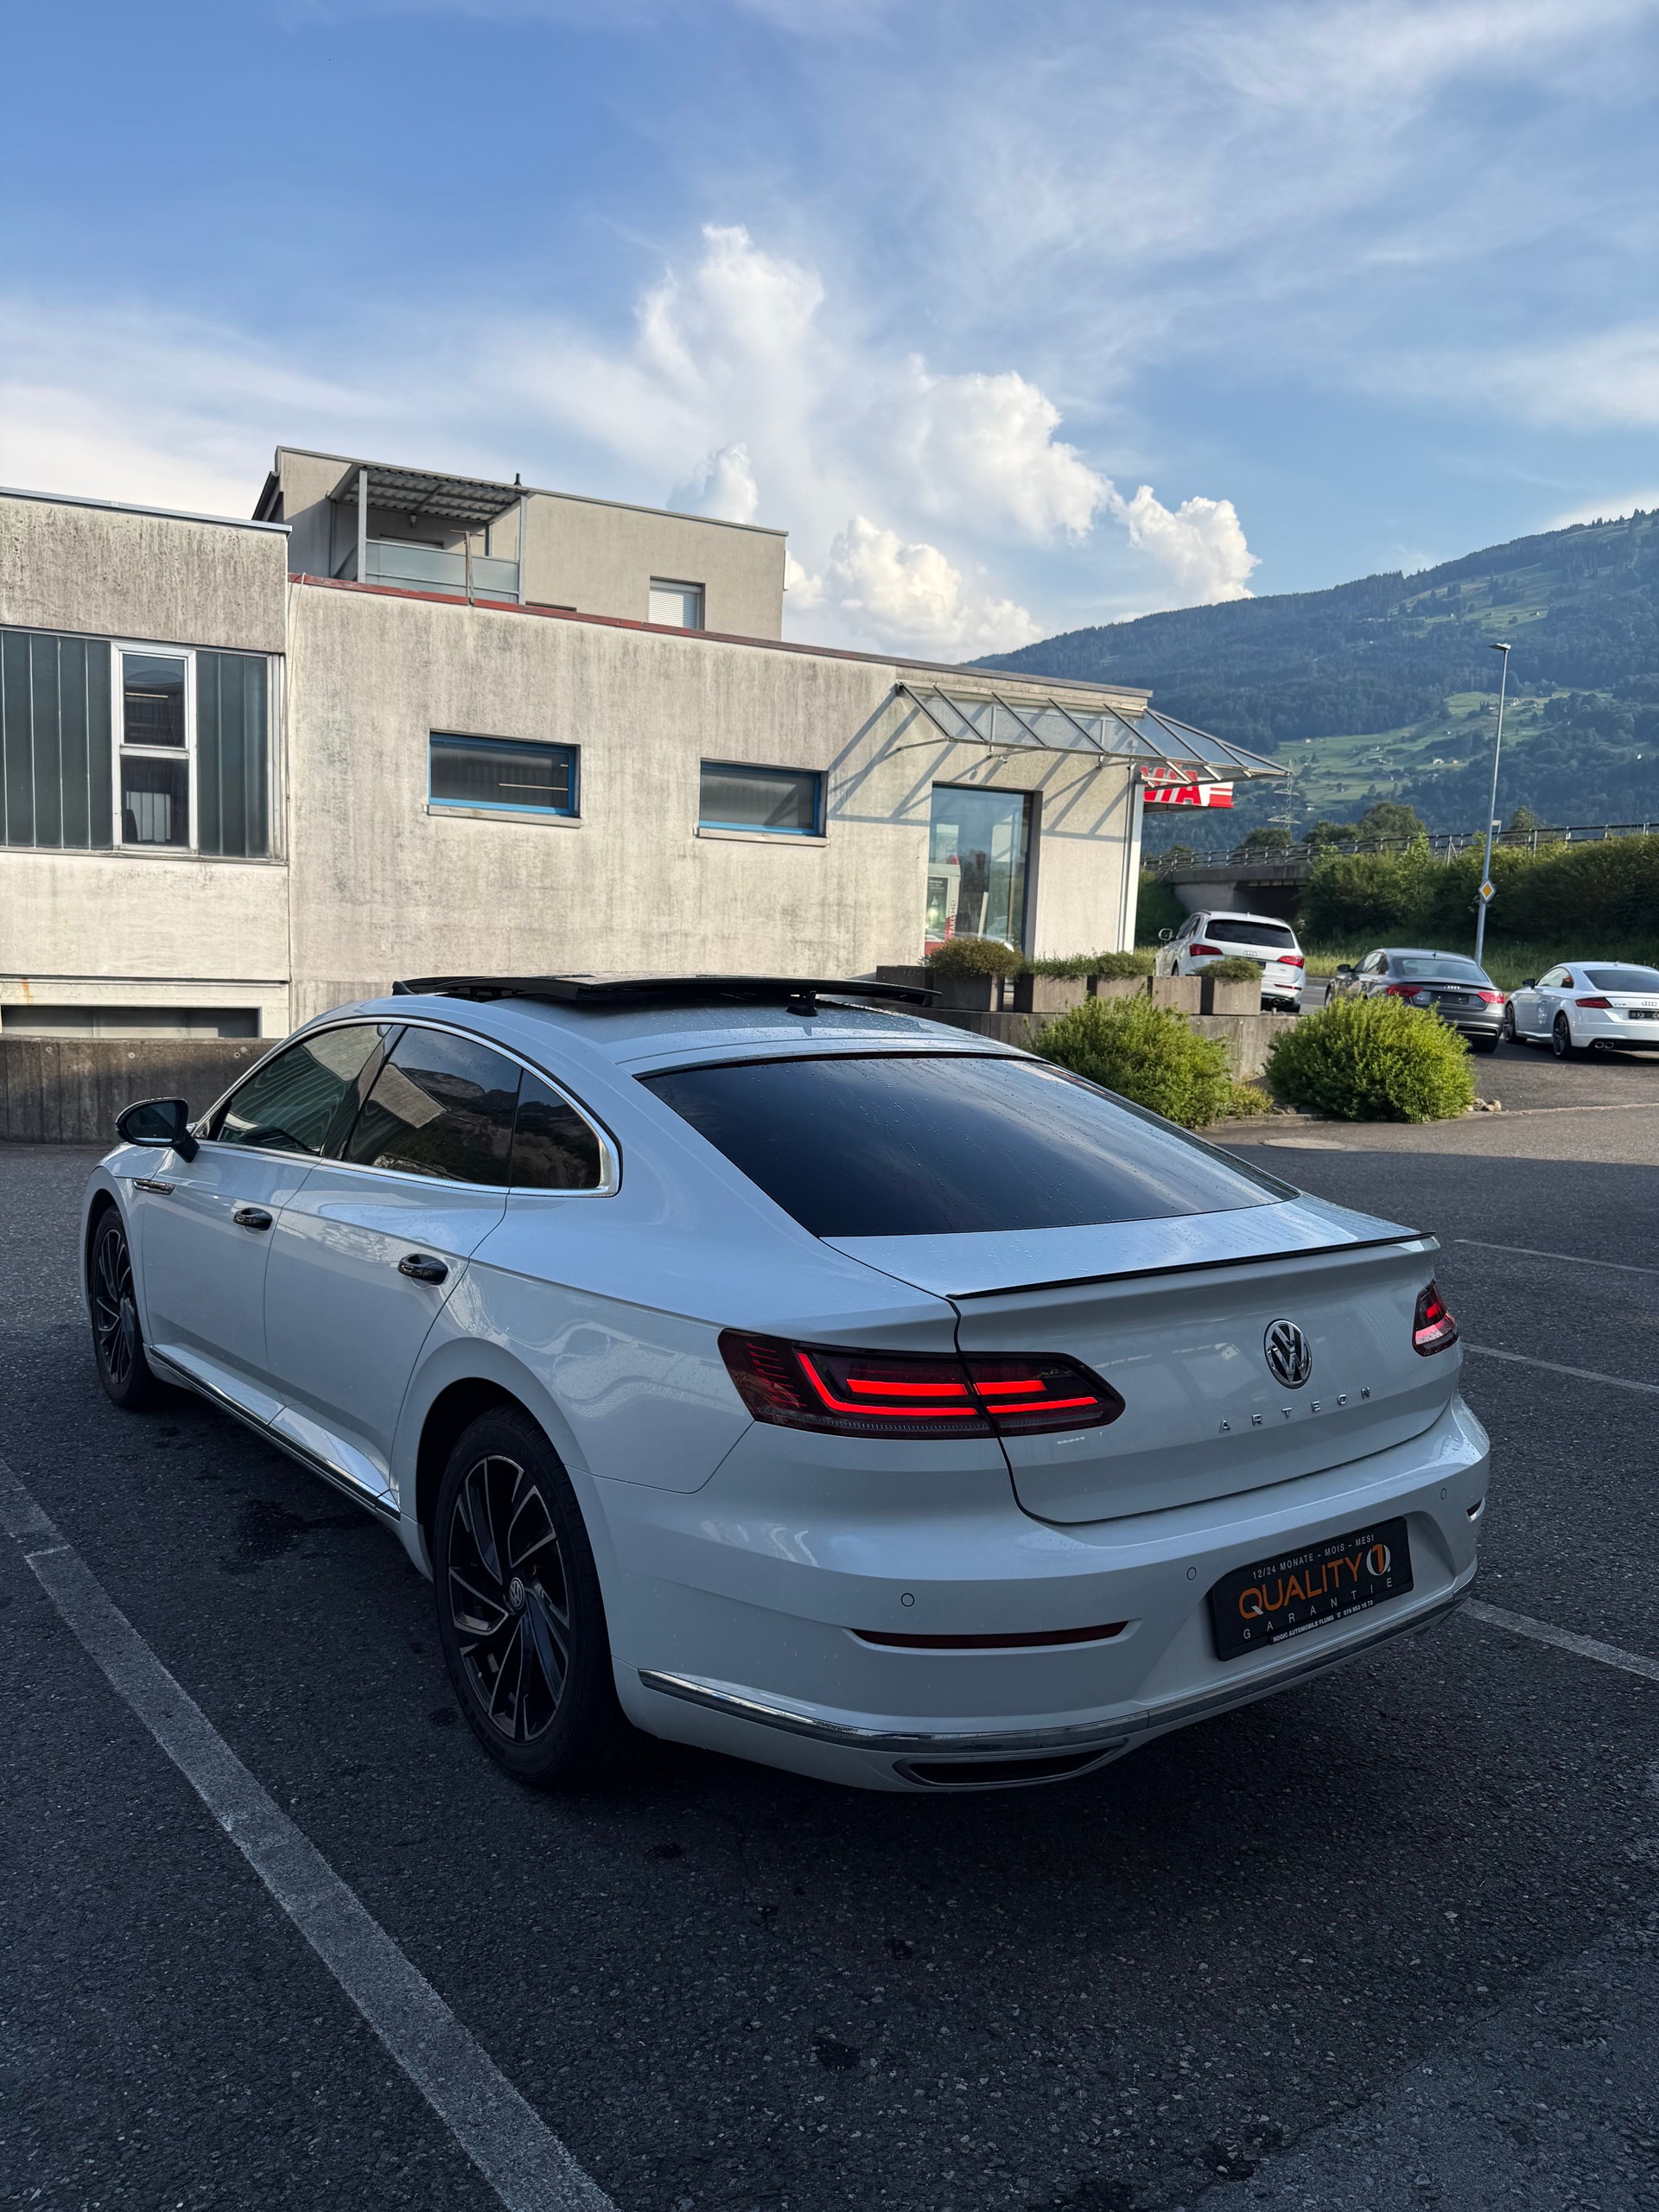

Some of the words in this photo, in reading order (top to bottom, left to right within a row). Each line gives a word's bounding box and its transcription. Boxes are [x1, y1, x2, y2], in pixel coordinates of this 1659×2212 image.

[1219, 1387, 1370, 1433] ARTEON
[1252, 1566, 1276, 1580] 12/24
[1280, 1553, 1314, 1571] MONATE
[1325, 1543, 1345, 1557] MOIS
[1355, 1534, 1375, 1547] MESI
[1238, 1552, 1363, 1619] QUALITY
[1243, 1577, 1393, 1639] GARANTIE
